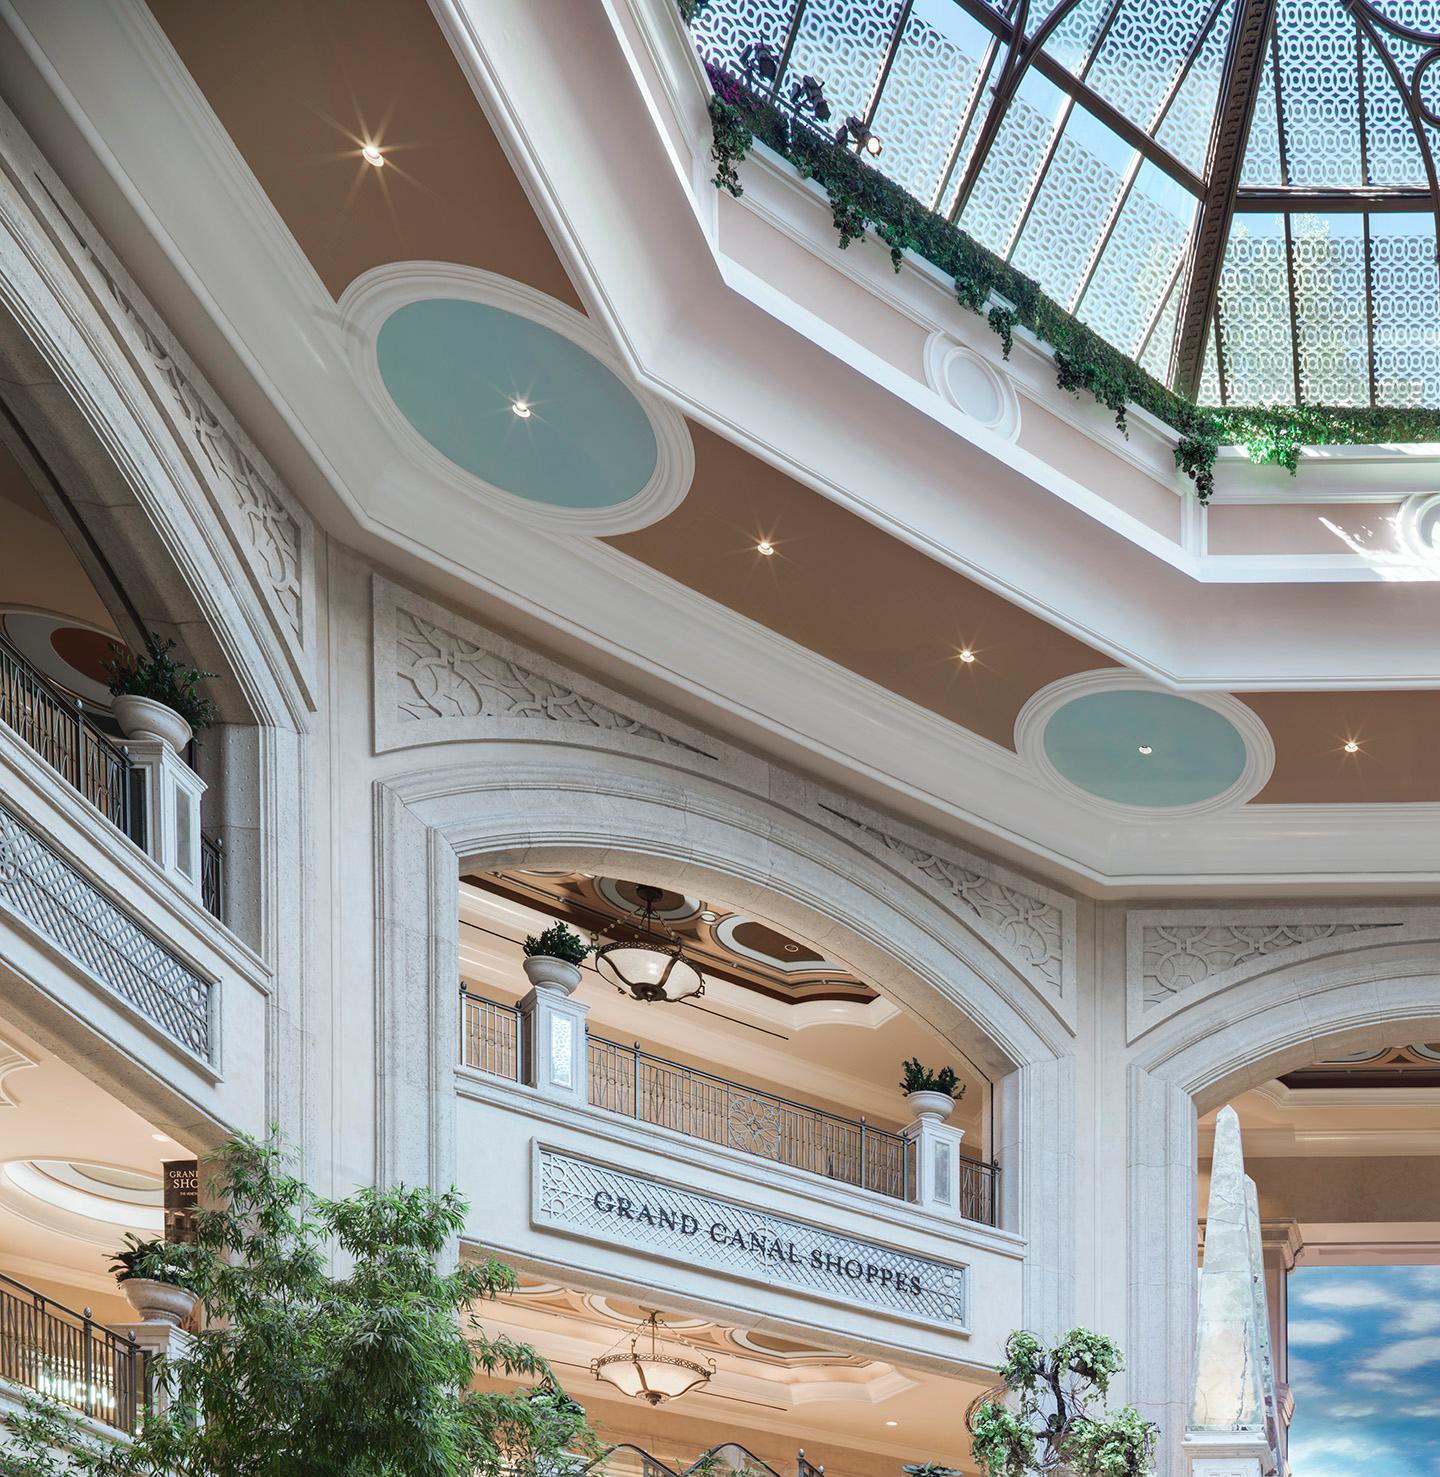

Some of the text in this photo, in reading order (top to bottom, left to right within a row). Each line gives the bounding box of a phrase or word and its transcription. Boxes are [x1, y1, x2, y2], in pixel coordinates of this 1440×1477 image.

[593, 1190, 923, 1297] GRAND CANAL SHOPPES
